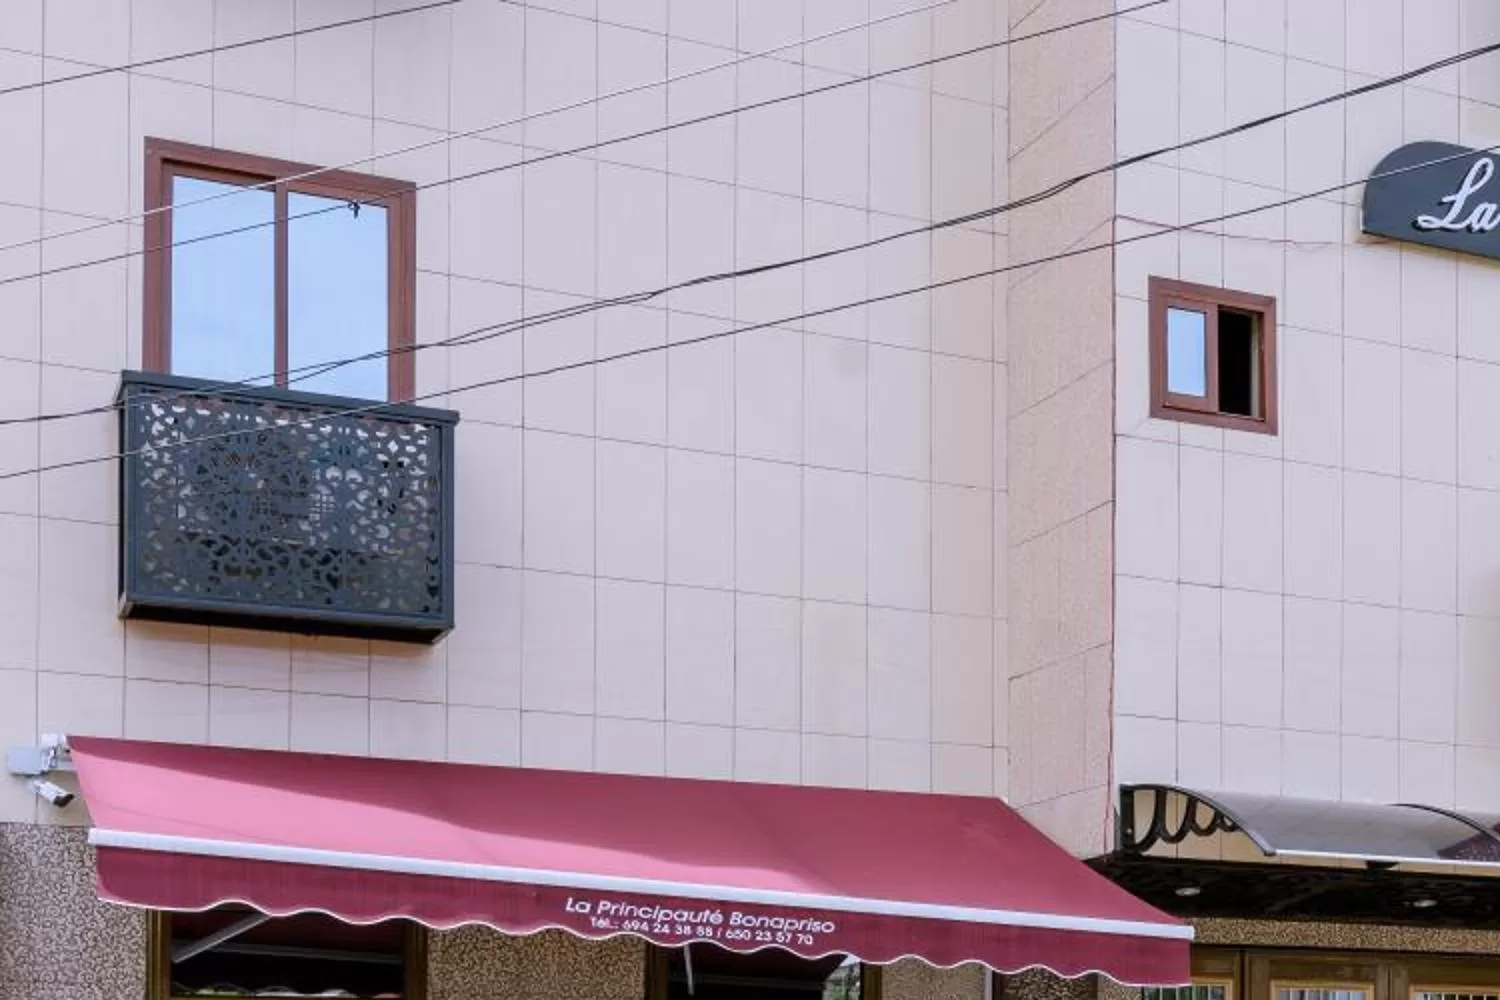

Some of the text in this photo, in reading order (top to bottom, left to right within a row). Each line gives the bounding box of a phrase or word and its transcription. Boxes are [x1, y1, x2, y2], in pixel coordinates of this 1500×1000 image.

[565, 896, 836, 934] La Principauté Bonapriso
[622, 919, 649, 932] 694
[653, 922, 670, 934] 24
[675, 924, 692, 936] 38
[696, 925, 713, 938] 88
[725, 929, 751, 941] 650
[755, 930, 772, 942] 23
[776, 932, 792, 944] 57
[796, 933, 813, 946] 70
